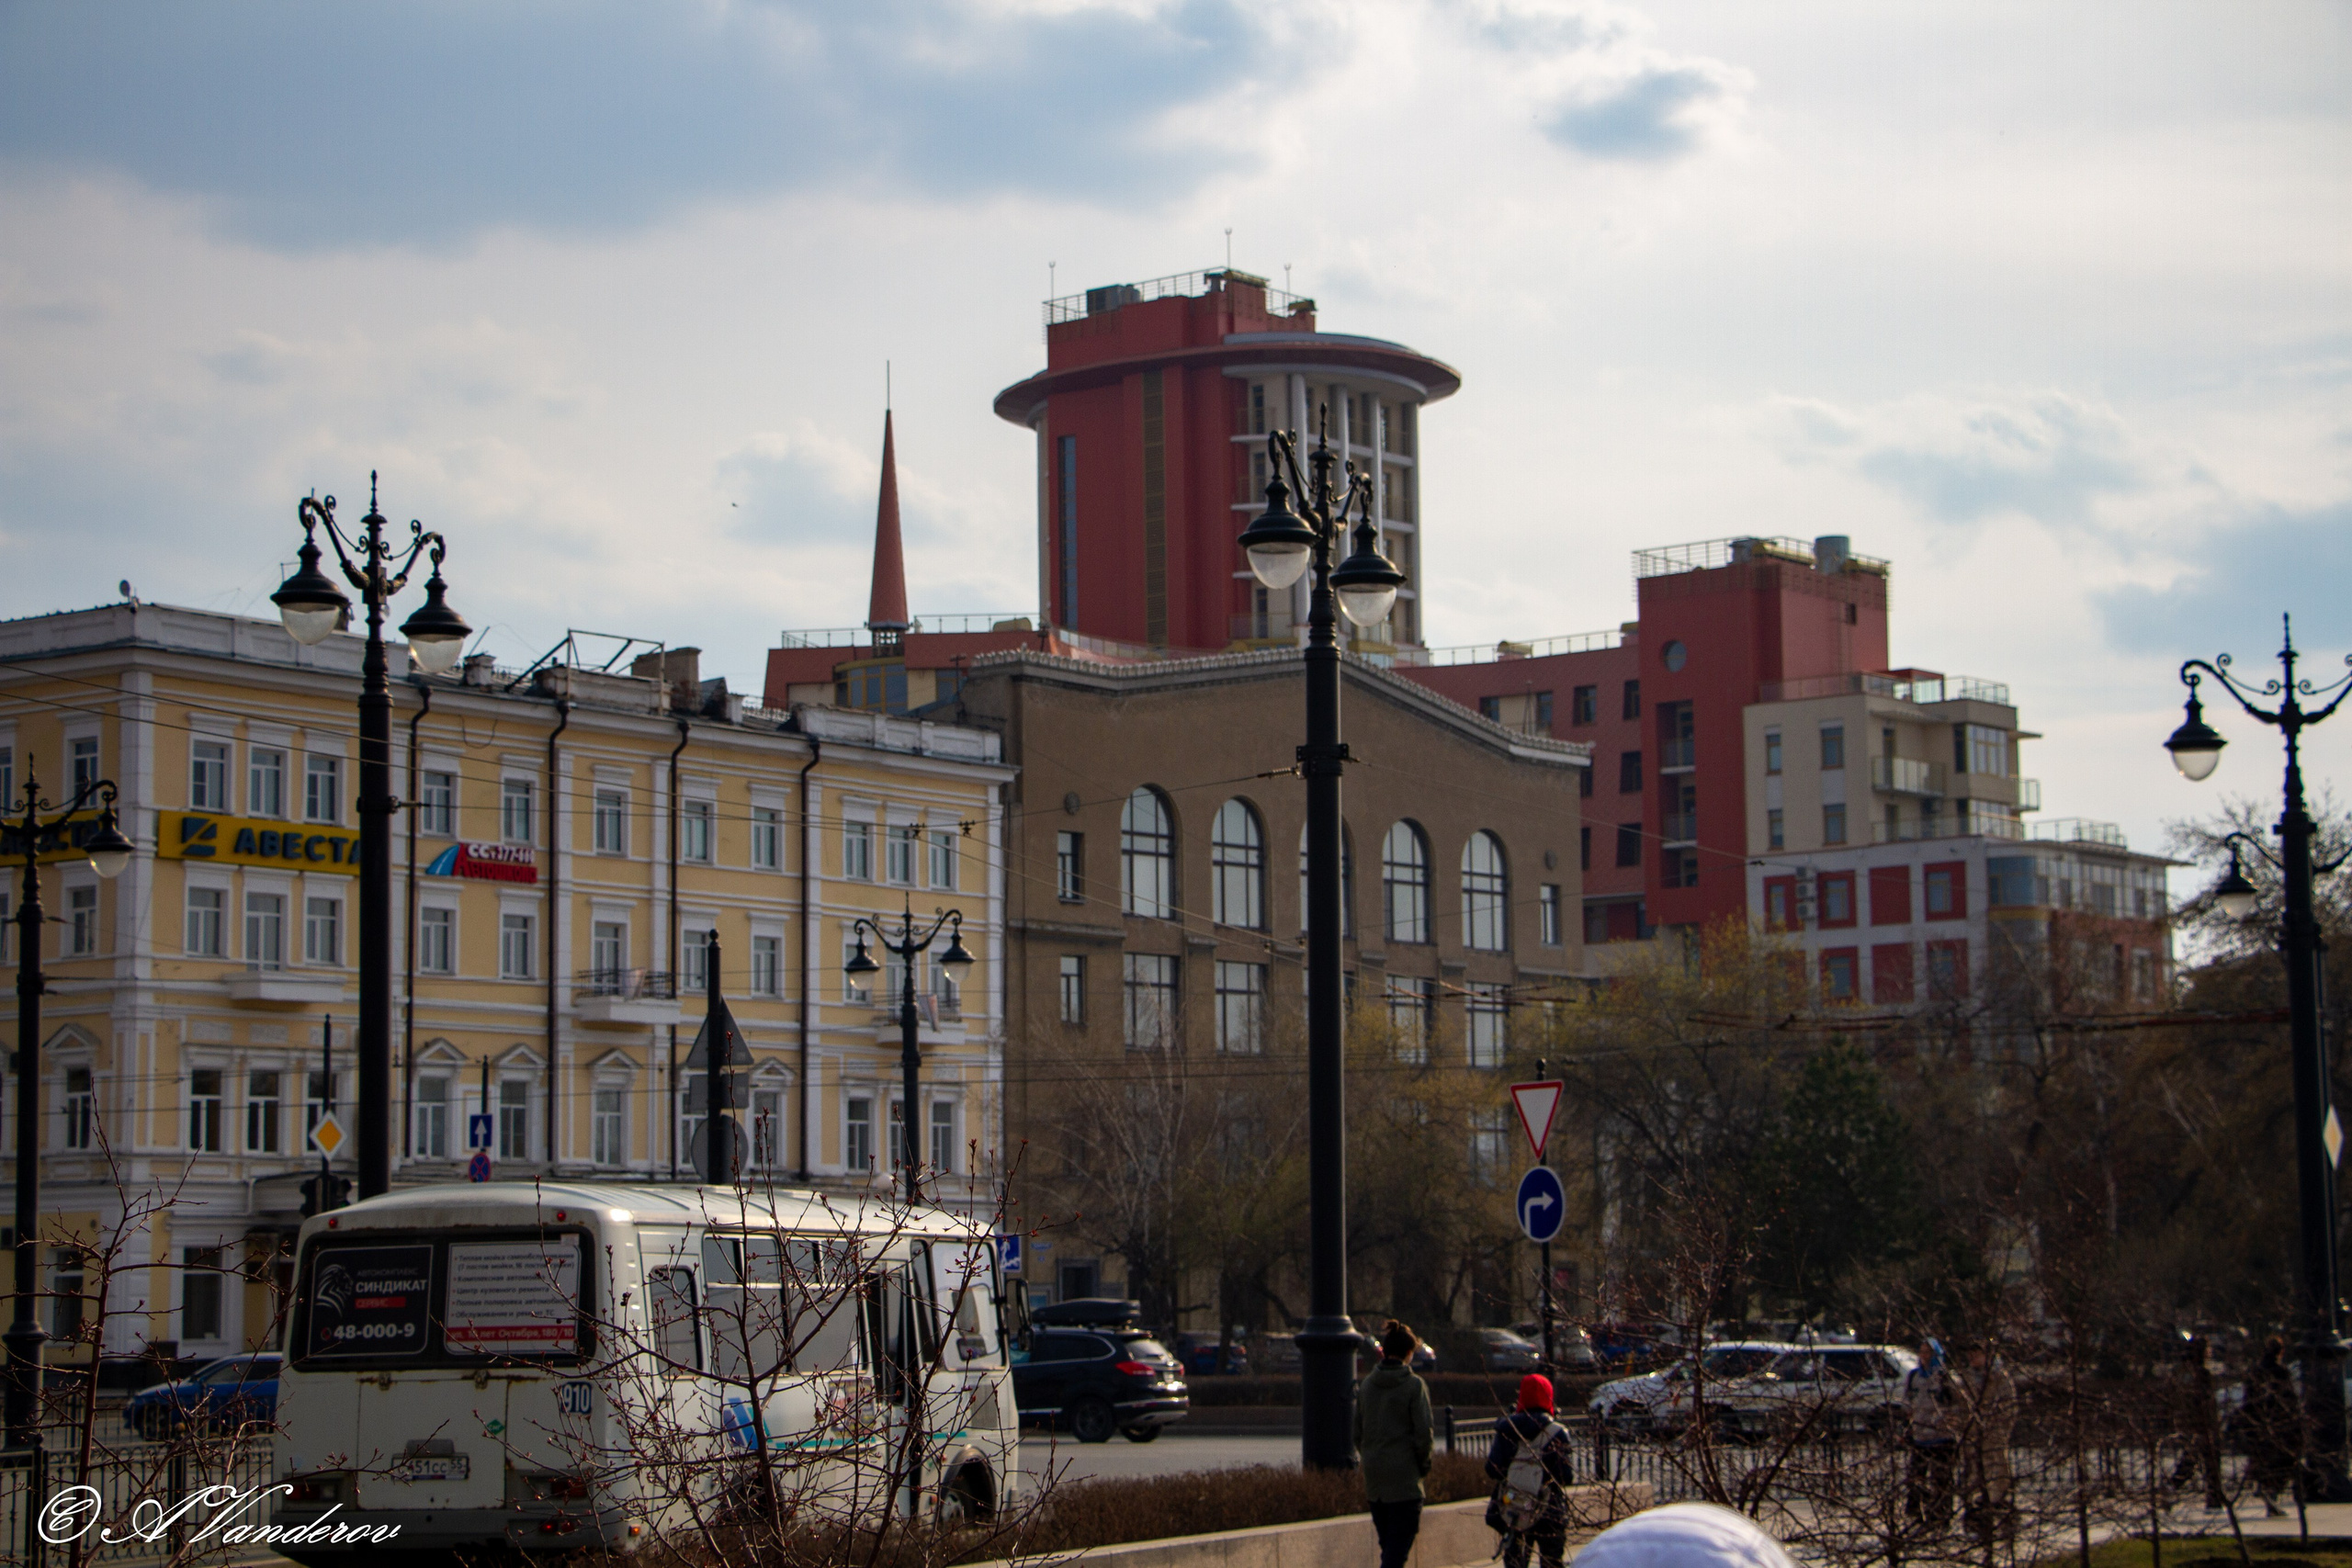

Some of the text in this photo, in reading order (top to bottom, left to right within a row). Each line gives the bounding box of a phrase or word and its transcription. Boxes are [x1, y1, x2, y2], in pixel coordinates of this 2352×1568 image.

[356, 1280, 427, 1294] СИНДИКАТ
[334, 1323, 415, 1340] 48-000-9
[563, 1383, 591, 1413] 910
